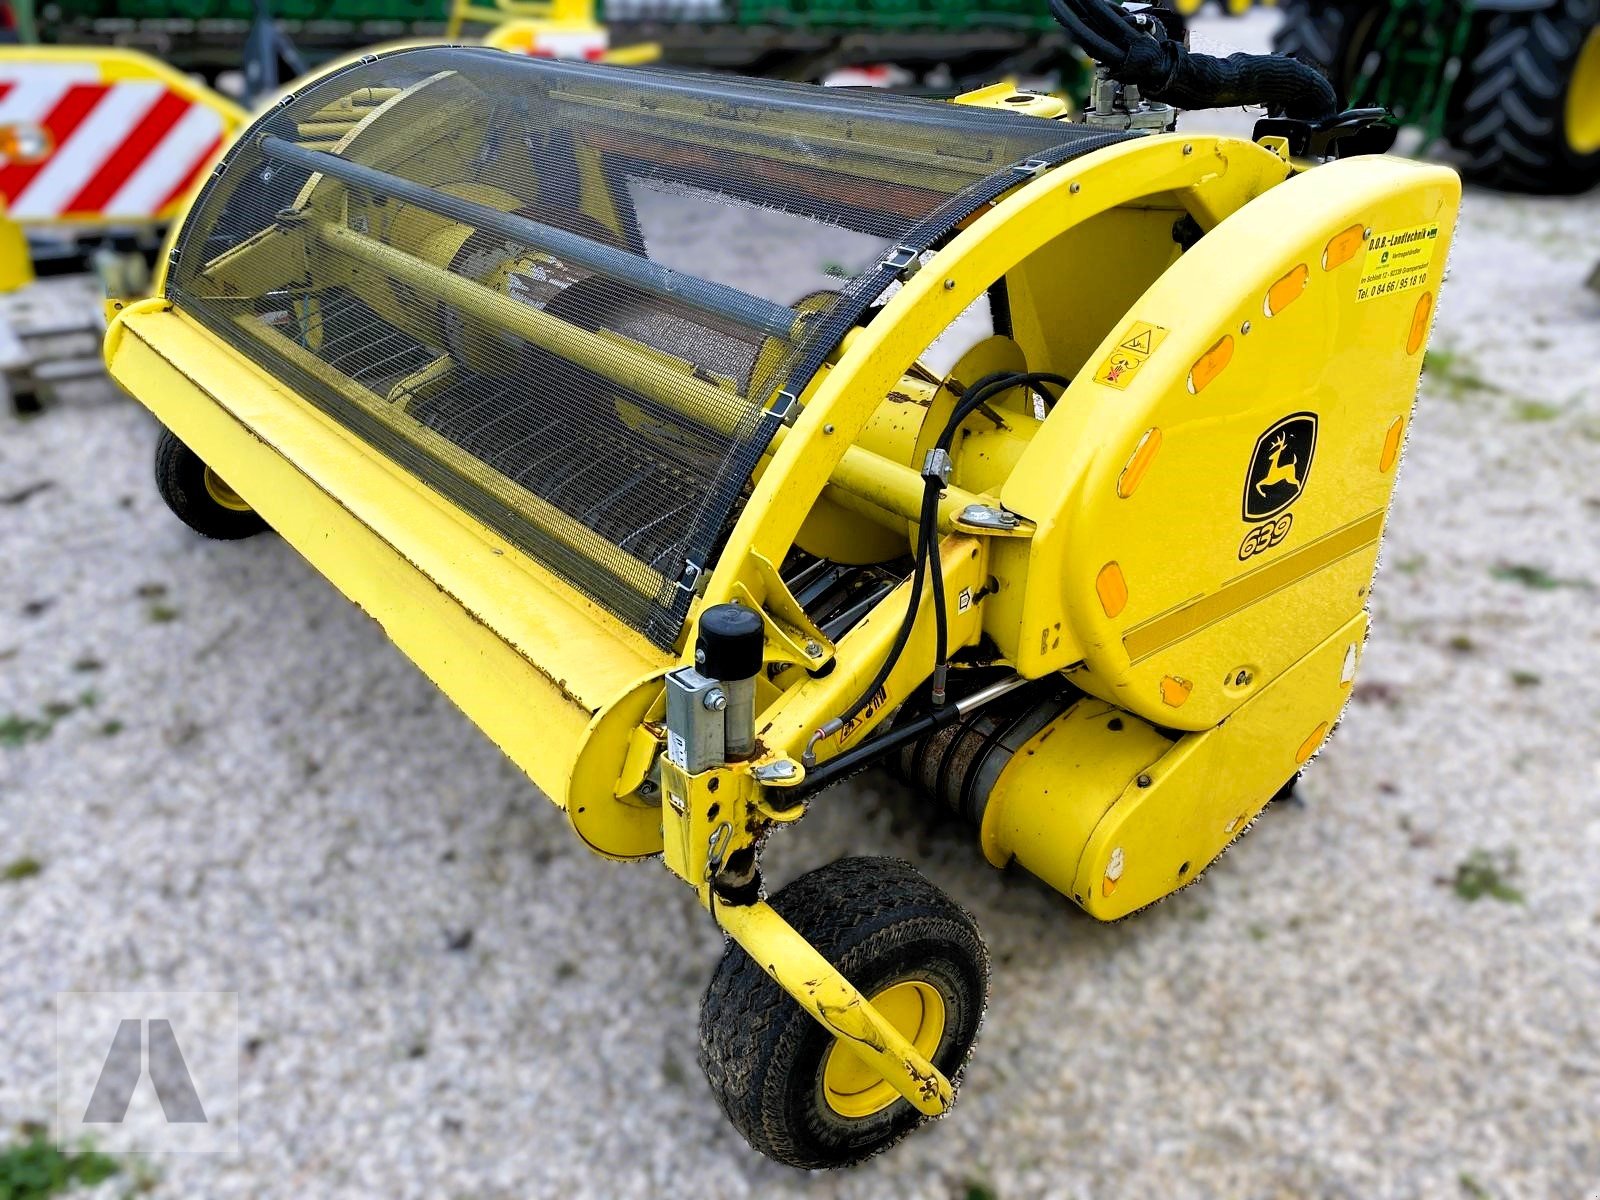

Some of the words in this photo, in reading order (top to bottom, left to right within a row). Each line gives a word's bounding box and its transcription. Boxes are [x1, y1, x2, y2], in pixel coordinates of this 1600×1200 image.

[1358, 288, 1369, 300] Tel.
[1370, 286, 1376, 297] 0
[1376, 283, 1386, 295] 84
[1386, 281, 1396, 292] 66
[1400, 278, 1408, 289] 95
[1409, 275, 1418, 286] 18
[1418, 273, 1427, 284] 10
[1238, 512, 1293, 562] 639
